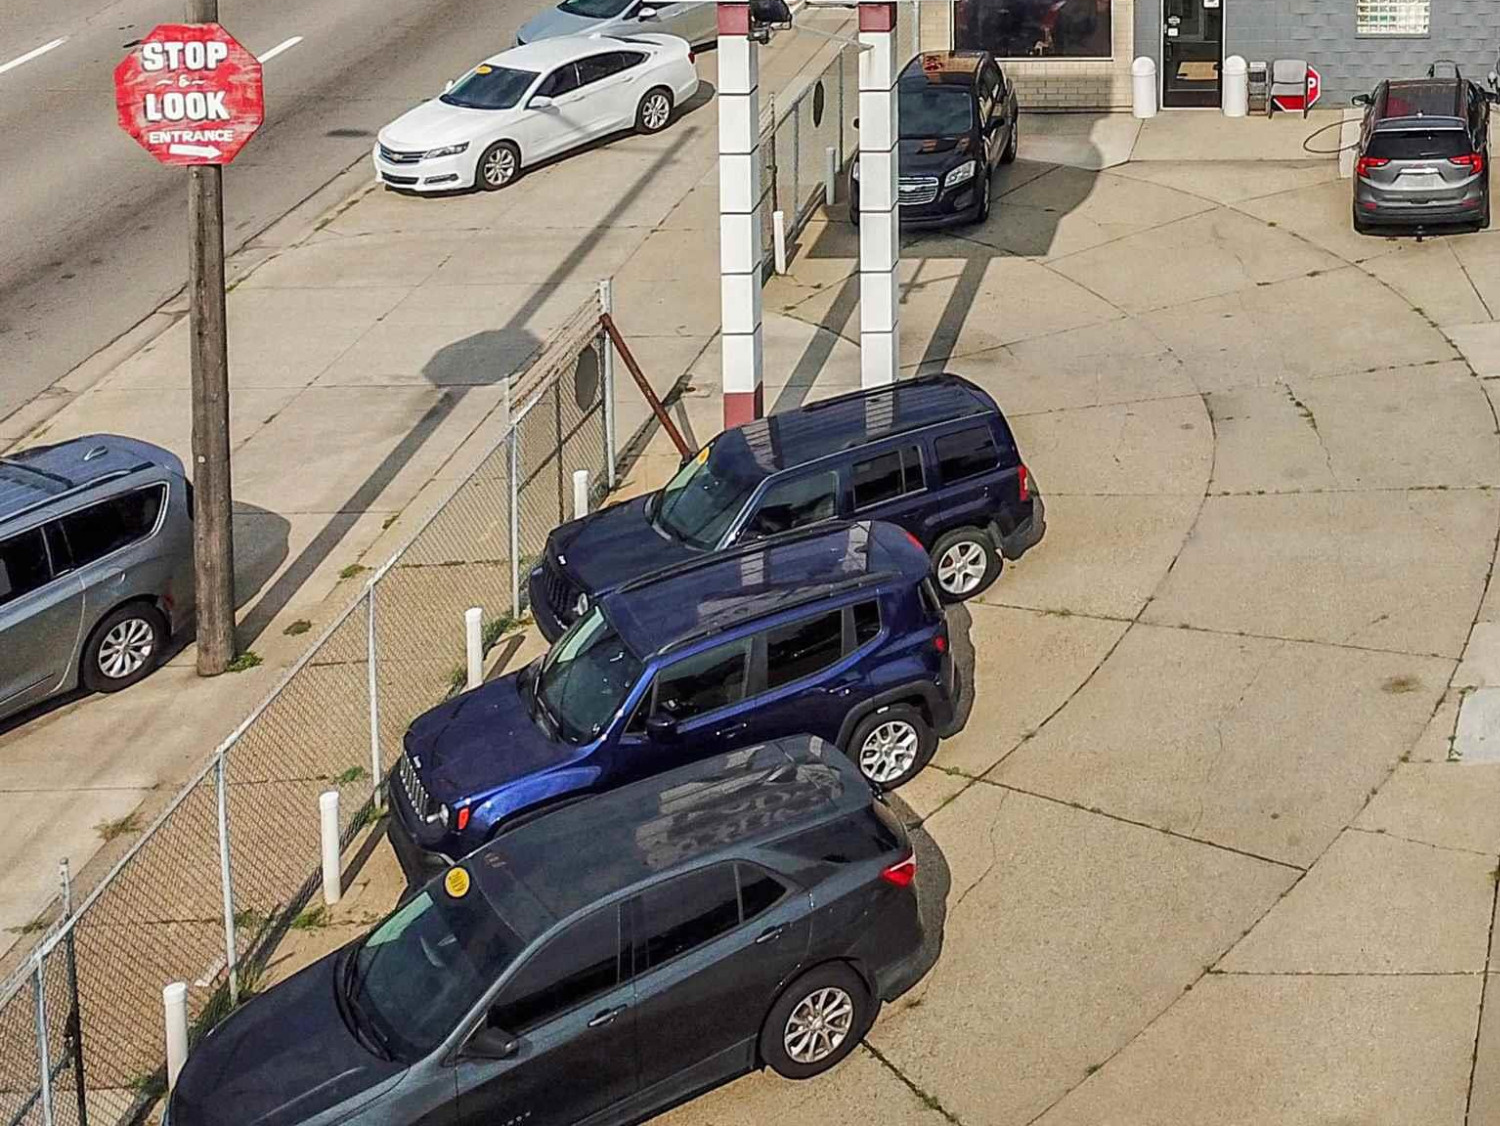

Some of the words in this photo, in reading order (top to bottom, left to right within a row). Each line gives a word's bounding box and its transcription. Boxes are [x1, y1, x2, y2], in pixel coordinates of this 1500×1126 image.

[142, 41, 228, 71] STOP
[145, 91, 230, 121] LOOK
[149, 129, 234, 144] ENTRANCE
